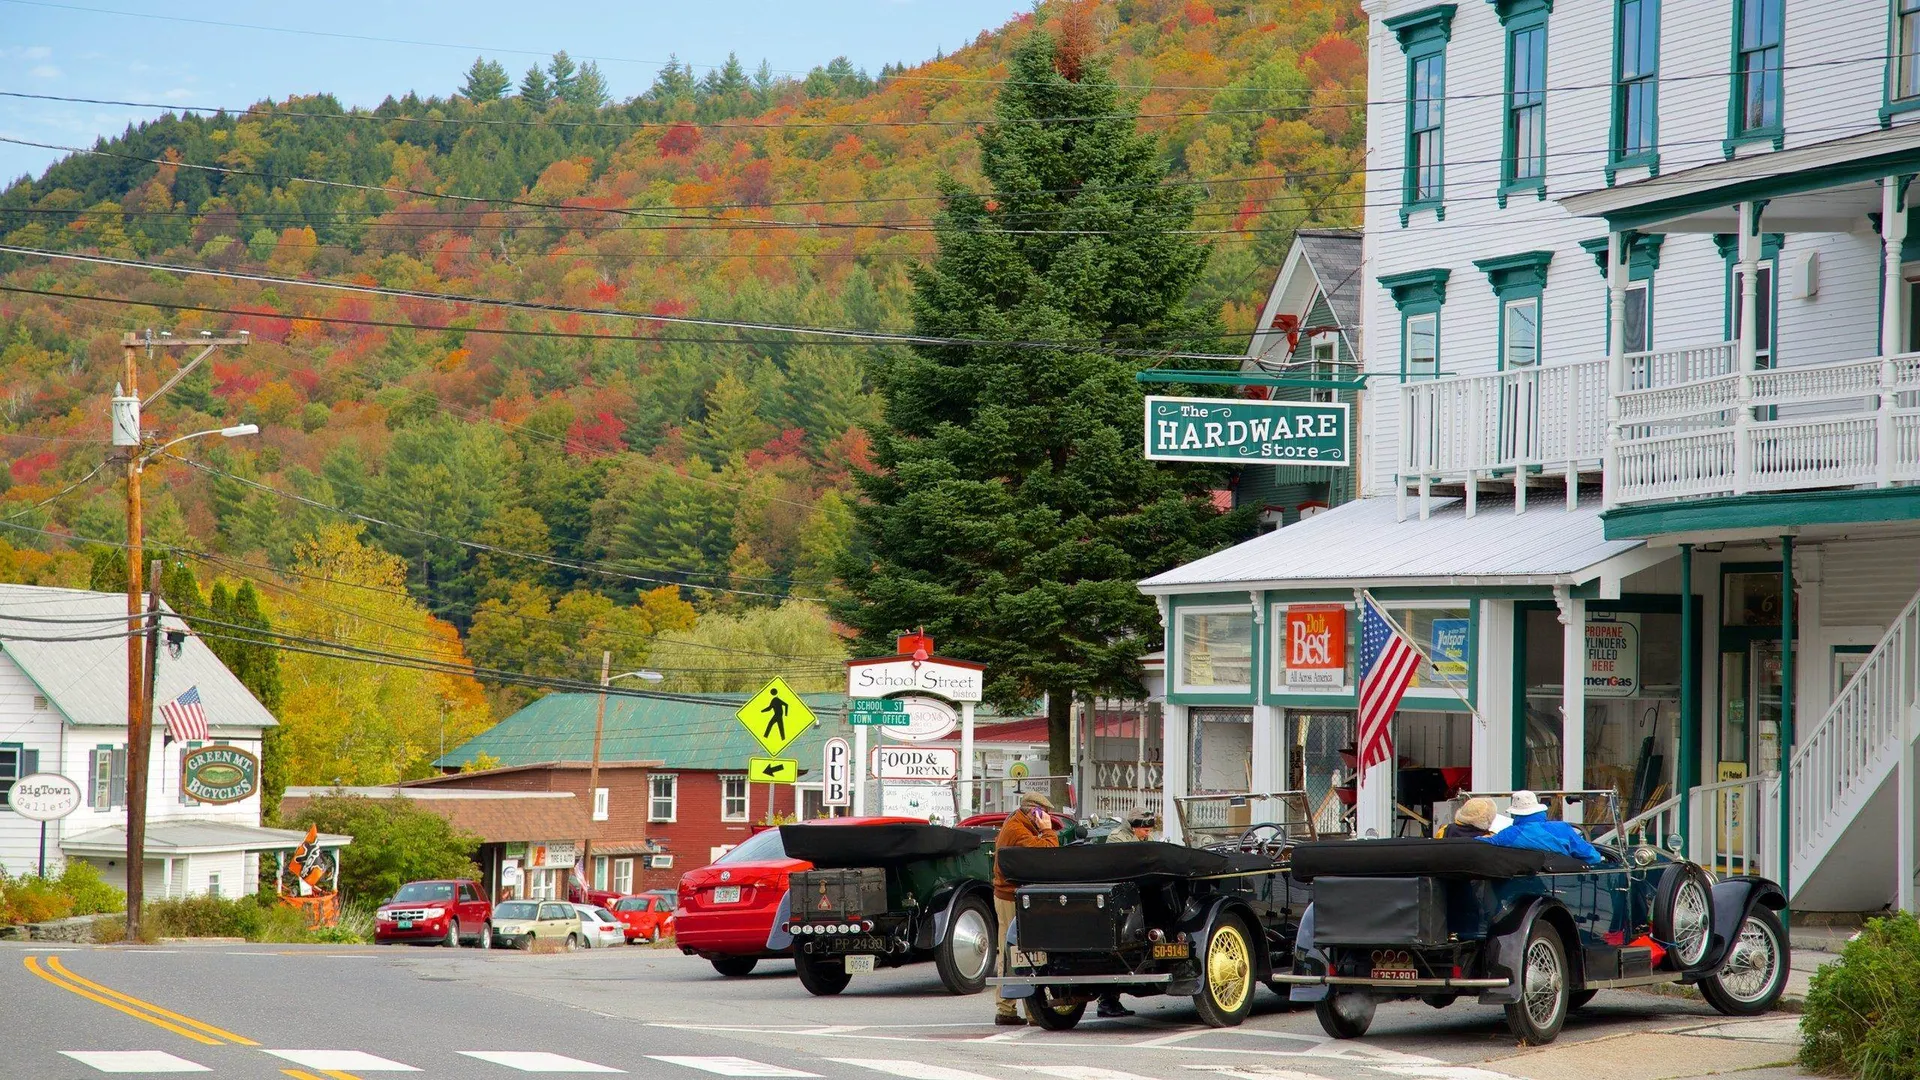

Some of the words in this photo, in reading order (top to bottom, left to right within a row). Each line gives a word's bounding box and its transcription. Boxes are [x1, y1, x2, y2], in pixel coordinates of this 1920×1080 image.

[1180, 405, 1209, 418] The
[1157, 414, 1337, 450] HARDWARE
[1261, 443, 1319, 458] Store
[1585, 626, 1623, 638] PROPANE
[1292, 620, 1331, 665] Best
[1585, 637, 1627, 649] YLINDERS
[1588, 648, 1618, 660] FILLED
[1592, 660, 1615, 672] HERE
[859, 668, 917, 687] School
[921, 670, 974, 689] Street
[1290, 671, 1298, 683] All
[1314, 671, 1333, 683] America
[1584, 675, 1632, 687] meriGas
[952, 690, 977, 698] bistro
[856, 701, 884, 711] SCHOOL
[894, 701, 903, 711] ST
[853, 714, 872, 724] TOWN
[882, 714, 907, 725] OFFICE
[188, 751, 231, 771] GREEN
[232, 753, 253, 773] MT.
[925, 752, 937, 765] &
[831, 746, 844, 801] PUB
[20, 784, 71, 797] BigTown
[187, 777, 252, 799] BICYCLES
[16, 797, 73, 812] Gallery
